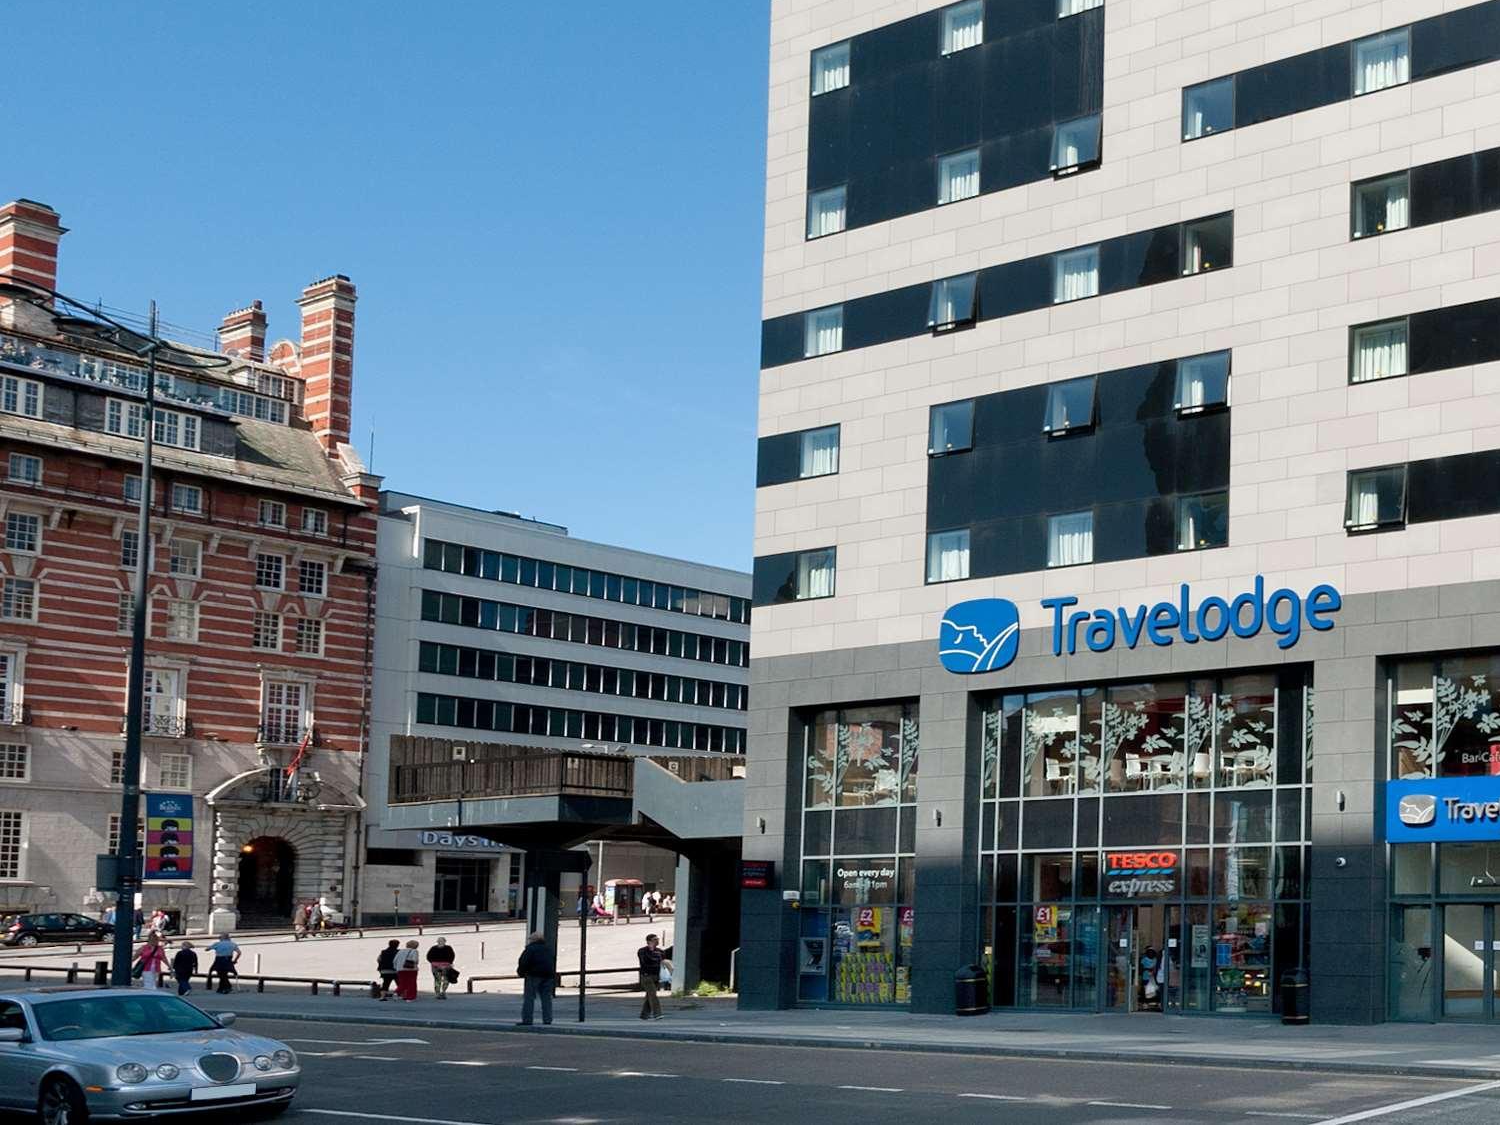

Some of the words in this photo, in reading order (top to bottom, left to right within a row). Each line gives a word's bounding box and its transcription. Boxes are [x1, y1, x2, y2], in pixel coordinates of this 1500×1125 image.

[1040, 575, 1342, 656] Travelodge
[423, 831, 478, 848] Days
[1107, 852, 1177, 868] TESCO
[837, 868, 858, 878] Open
[859, 869, 879, 878] every
[880, 867, 895, 878] day
[1108, 877, 1175, 897] express
[860, 909, 873, 921] £2
[1036, 907, 1051, 921] £1
